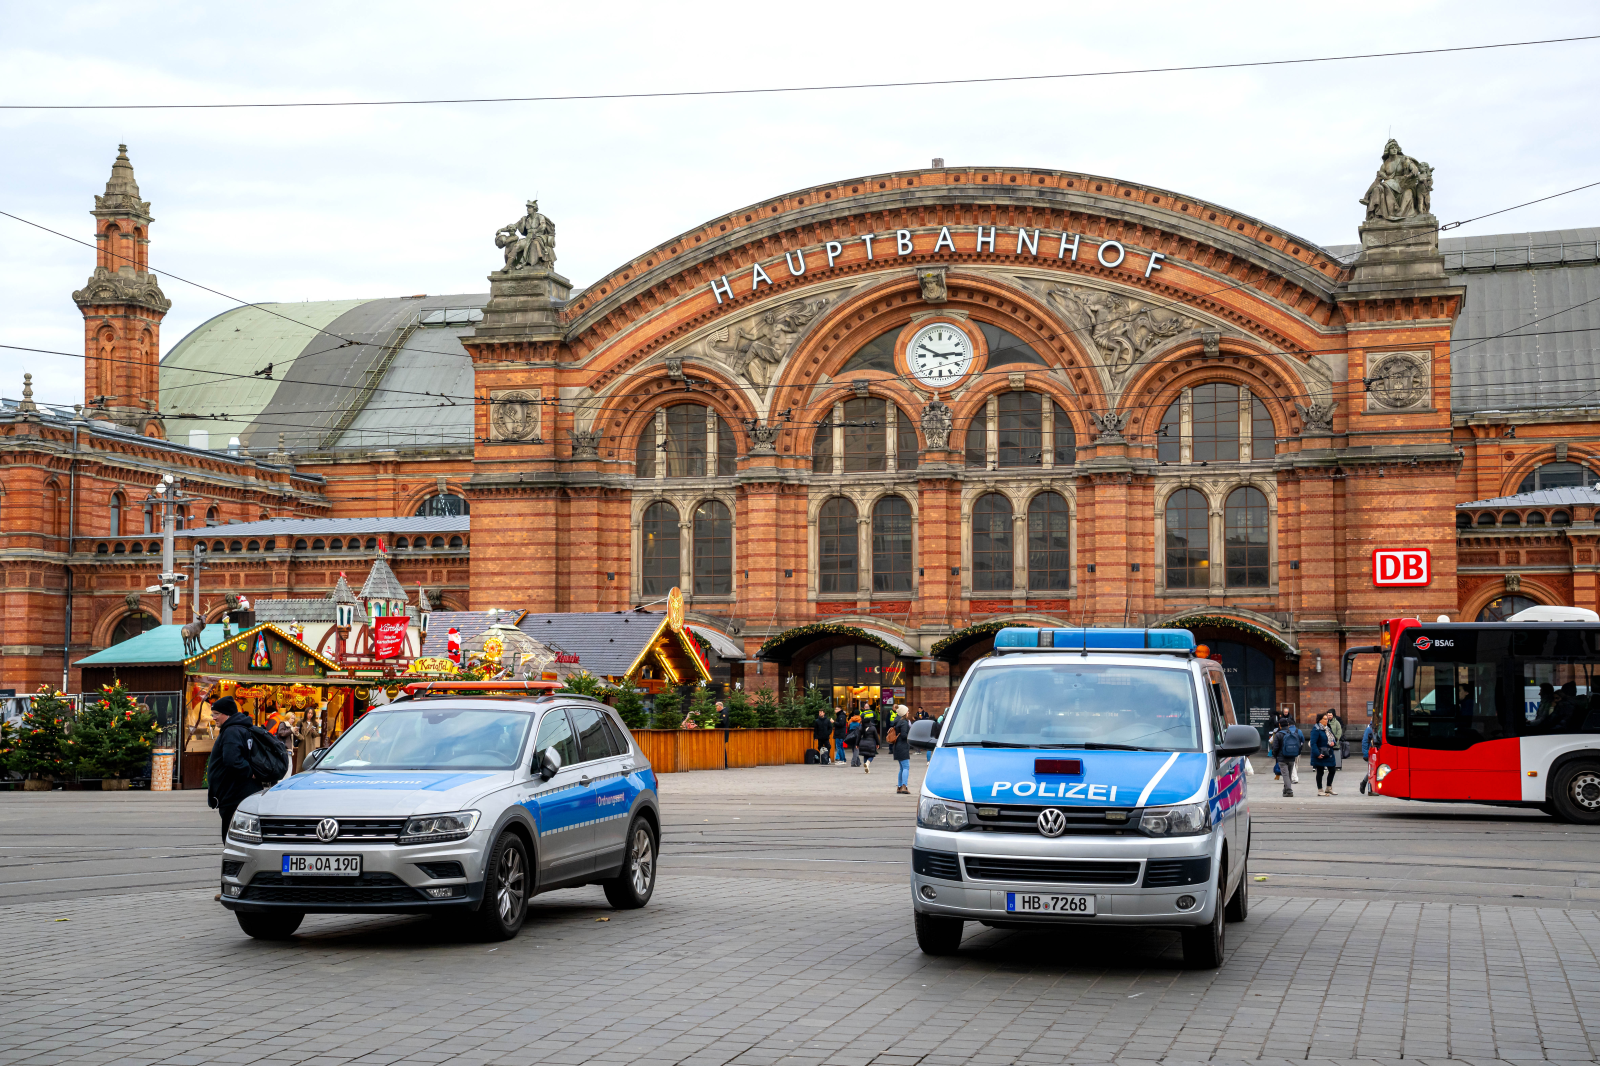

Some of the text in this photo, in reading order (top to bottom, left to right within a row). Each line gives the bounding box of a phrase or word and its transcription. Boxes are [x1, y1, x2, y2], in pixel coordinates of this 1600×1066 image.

[710, 226, 1166, 304] HAUPTBAHNHOF
[1379, 553, 1425, 581] DB
[1434, 639, 1454, 647] BSAG
[990, 781, 1118, 802] POLIZEI
[290, 857, 307, 871] HB
[315, 857, 331, 871] OA
[334, 857, 358, 871] 190
[1022, 895, 1041, 910] HB
[1050, 896, 1087, 911] 7268
